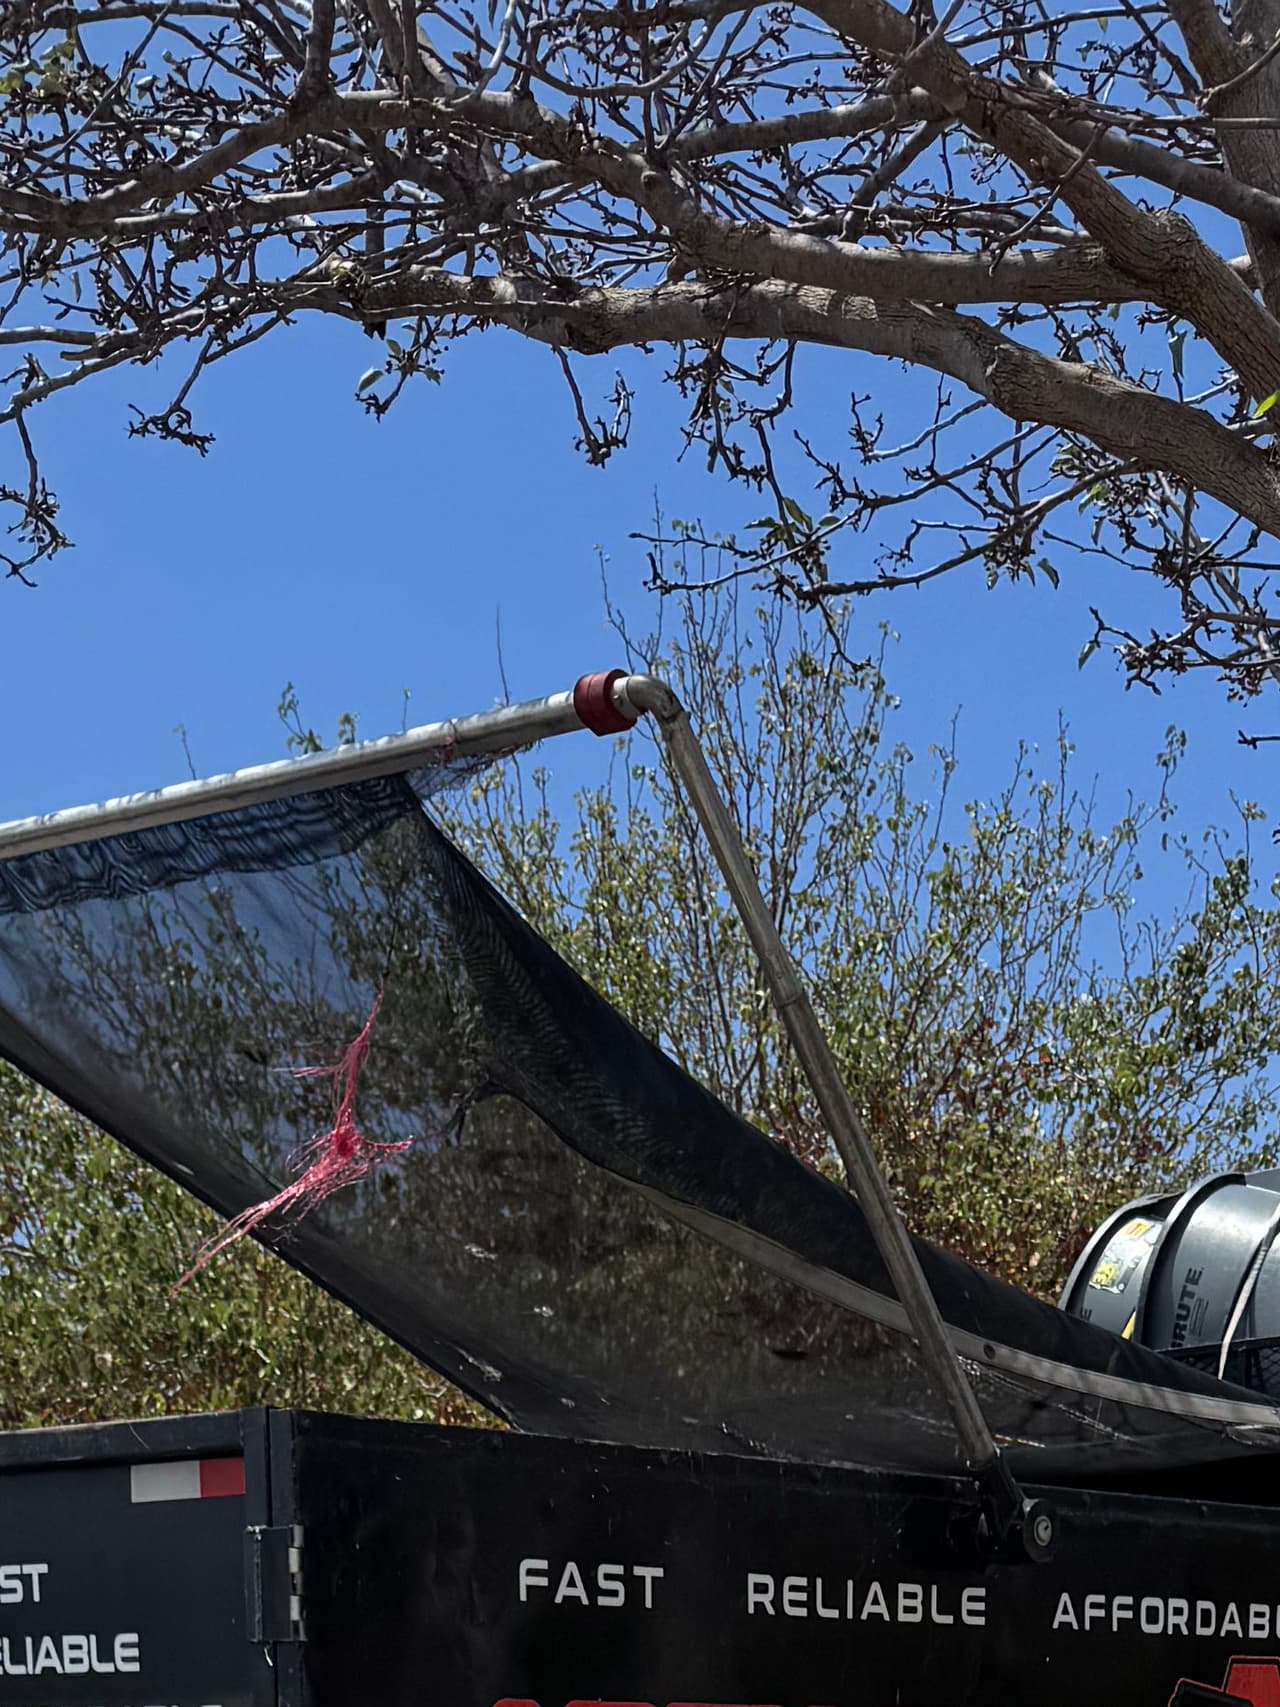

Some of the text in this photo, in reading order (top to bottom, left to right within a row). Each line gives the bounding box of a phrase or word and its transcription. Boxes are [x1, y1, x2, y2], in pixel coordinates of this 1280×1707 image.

[1171, 1266, 1203, 1349] RUTE
[519, 1558, 666, 1608] FAST
[746, 1572, 987, 1626] RELIABLE
